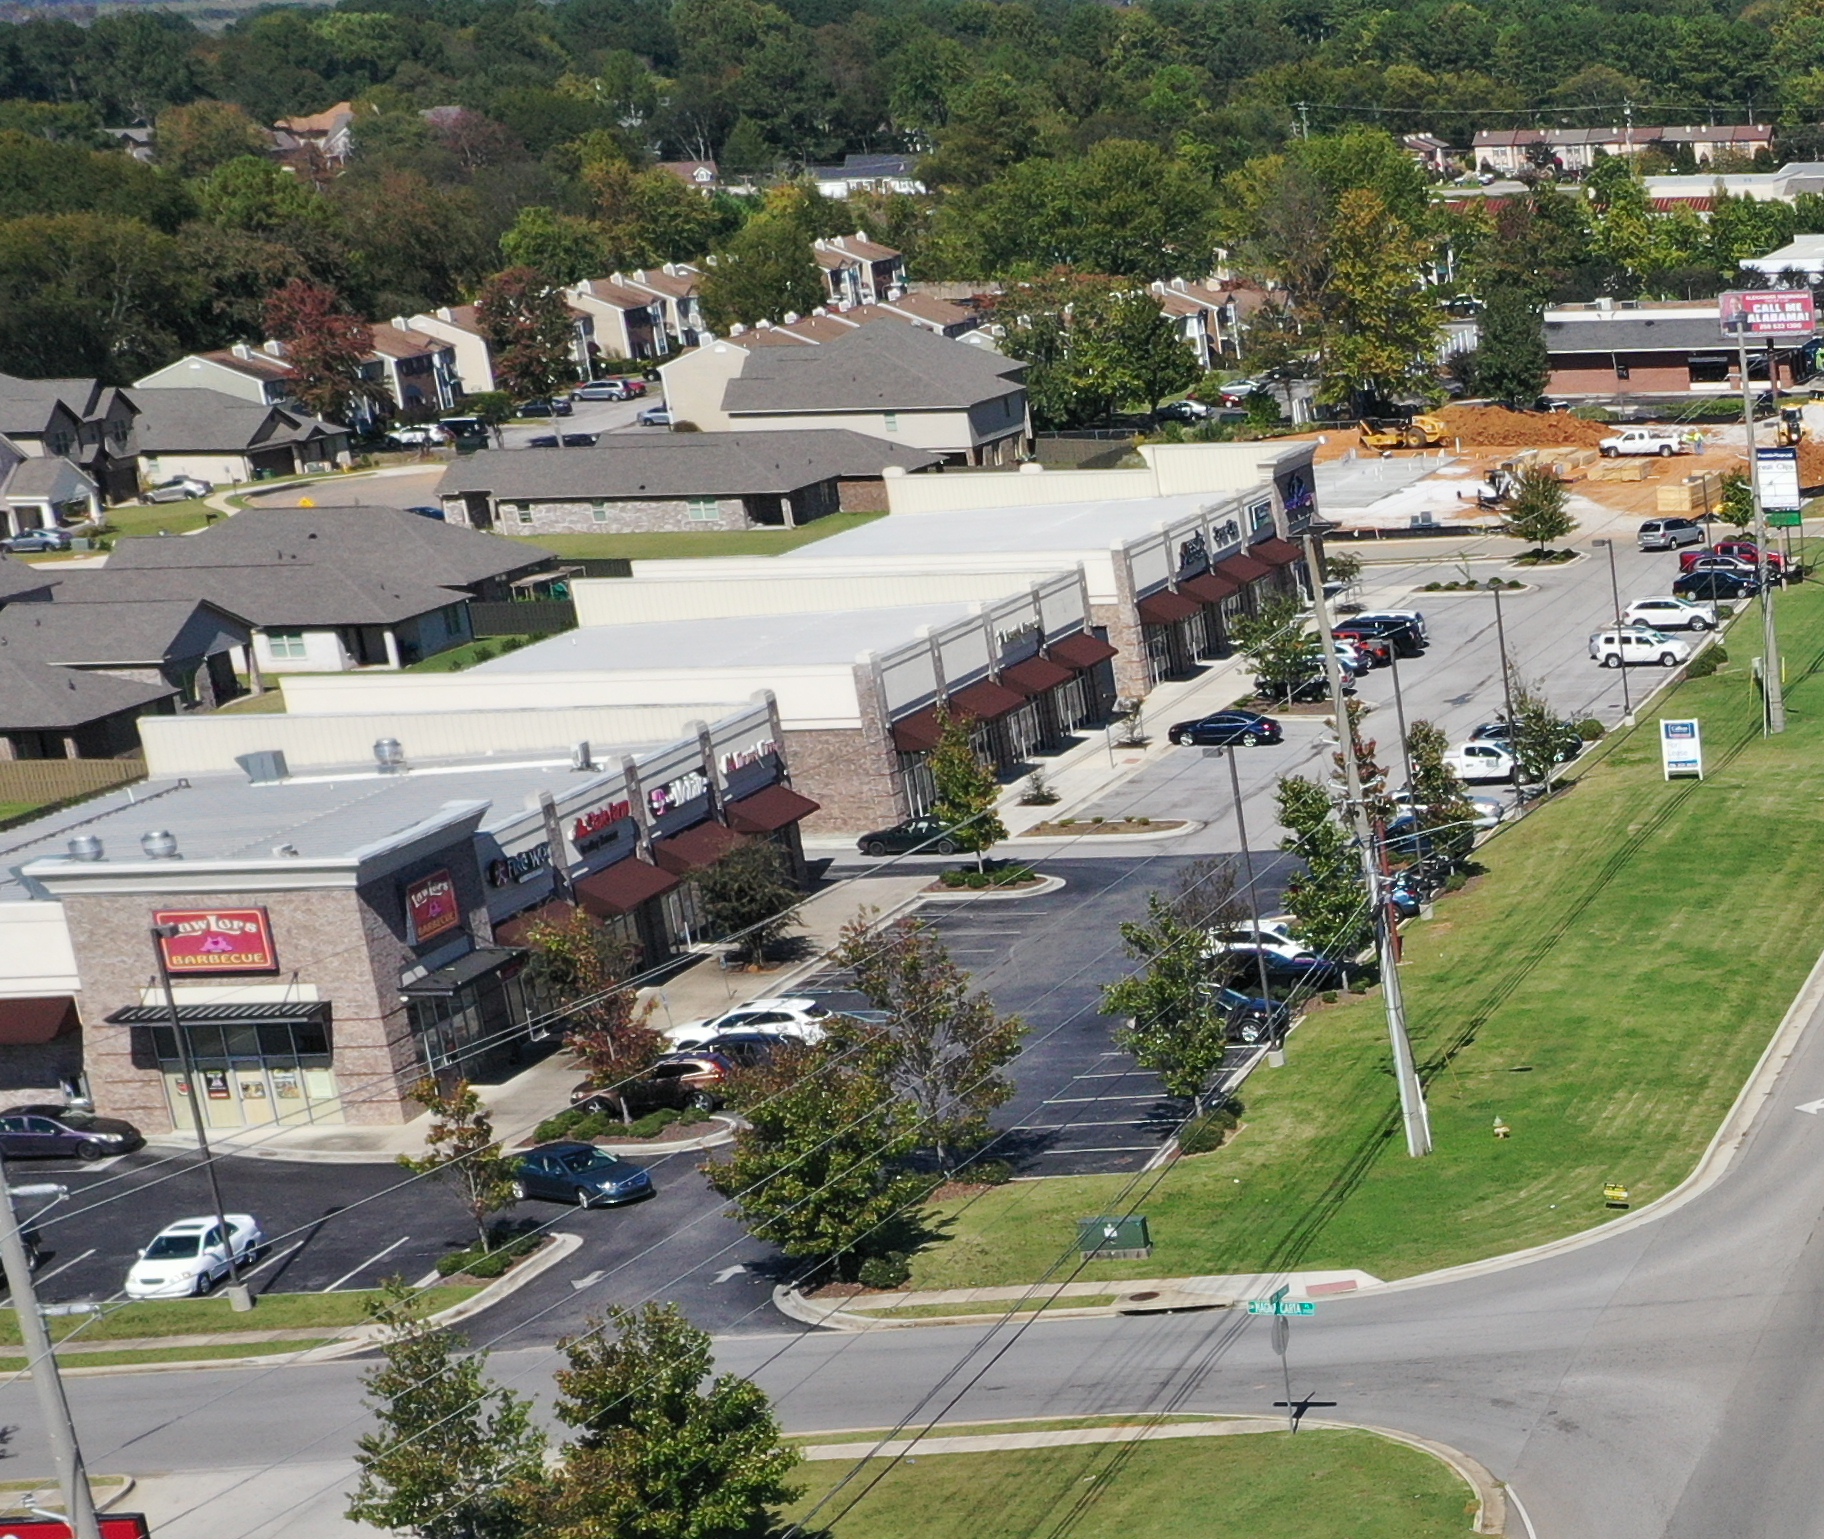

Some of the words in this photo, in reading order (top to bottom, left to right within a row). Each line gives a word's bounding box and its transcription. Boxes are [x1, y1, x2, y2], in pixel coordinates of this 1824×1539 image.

[1752, 303, 1781, 313] CALL
[1784, 302, 1803, 312] ME
[1747, 312, 1810, 324] ALABAMA!
[171, 915, 258, 938] awLers
[171, 953, 265, 965] BARBECUE
